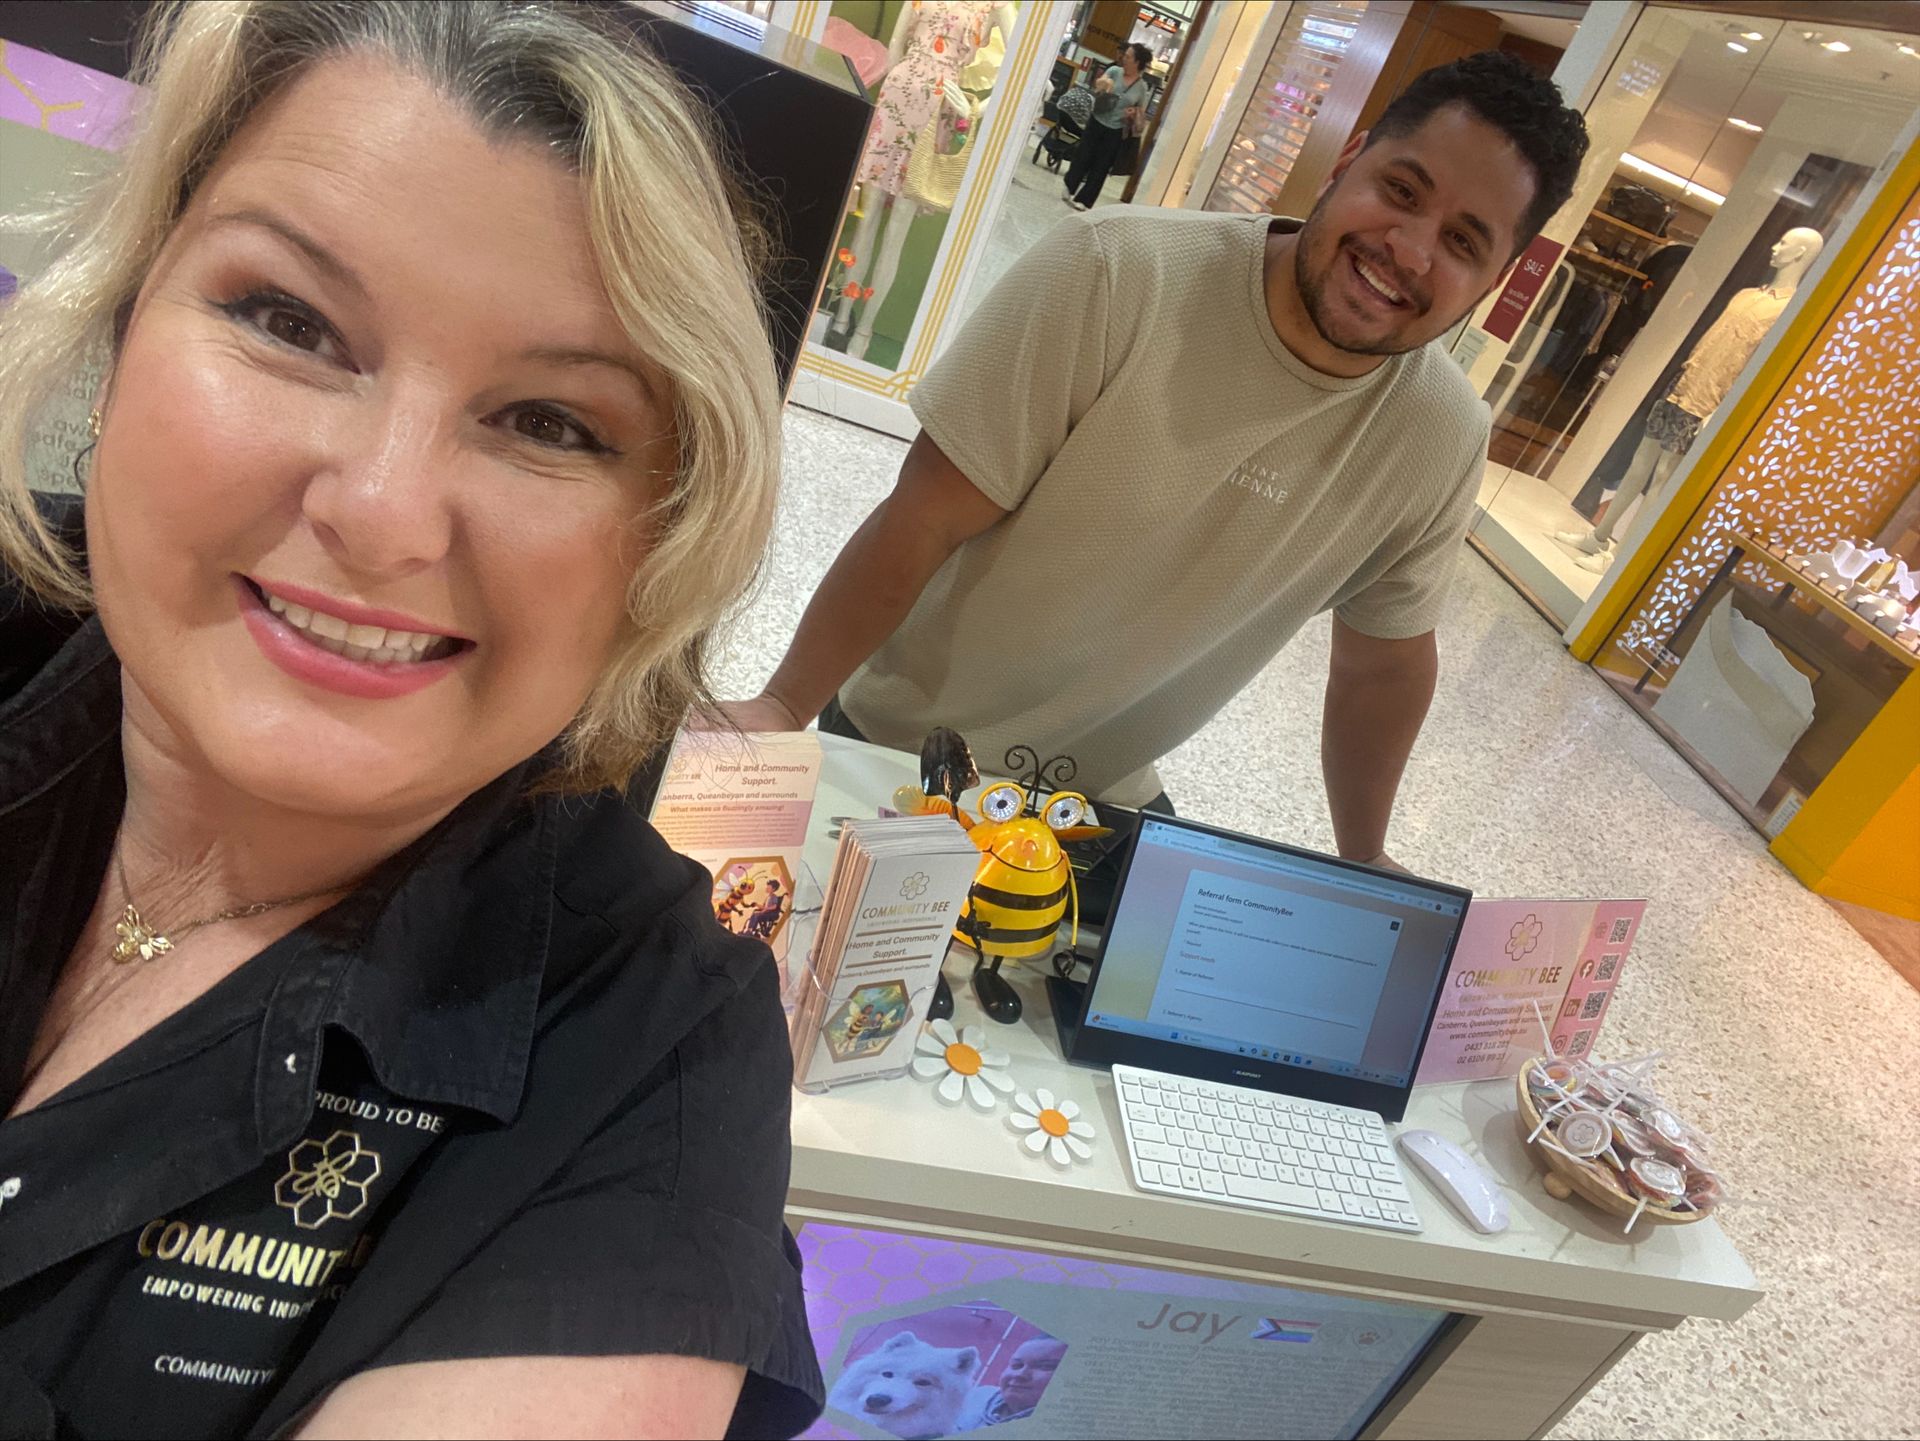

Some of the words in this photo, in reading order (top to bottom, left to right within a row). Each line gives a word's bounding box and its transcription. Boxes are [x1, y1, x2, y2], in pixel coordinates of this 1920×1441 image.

[1524, 258, 1546, 277] SALE
[715, 763, 741, 773] Home
[743, 763, 759, 773] and
[761, 763, 810, 774] Community
[741, 776, 778, 787] Support.
[746, 792, 760, 800] and
[761, 791, 798, 799] surrounds
[670, 804, 688, 813] What
[689, 804, 712, 813] makes
[862, 902, 930, 920] COMMUNITY
[931, 900, 951, 913] BEE
[1198, 888, 1224, 901] Referral
[1225, 894, 1242, 905] form
[1243, 899, 1294, 917] CommunityBee
[848, 940, 875, 950] Home
[875, 936, 892, 947] and
[893, 932, 940, 945] Community
[1455, 967, 1539, 989] COMMUNITY
[1538, 965, 1562, 984] BEE
[1467, 1006, 1482, 1017] and
[313, 1089, 380, 1121] PROUD
[386, 1107, 413, 1127] TO
[416, 1112, 446, 1134] BE
[137, 1218, 346, 1287] COMMUNIT
[142, 1275, 264, 1314] EMPOWERING
[1136, 1302, 1243, 1345] Jay
